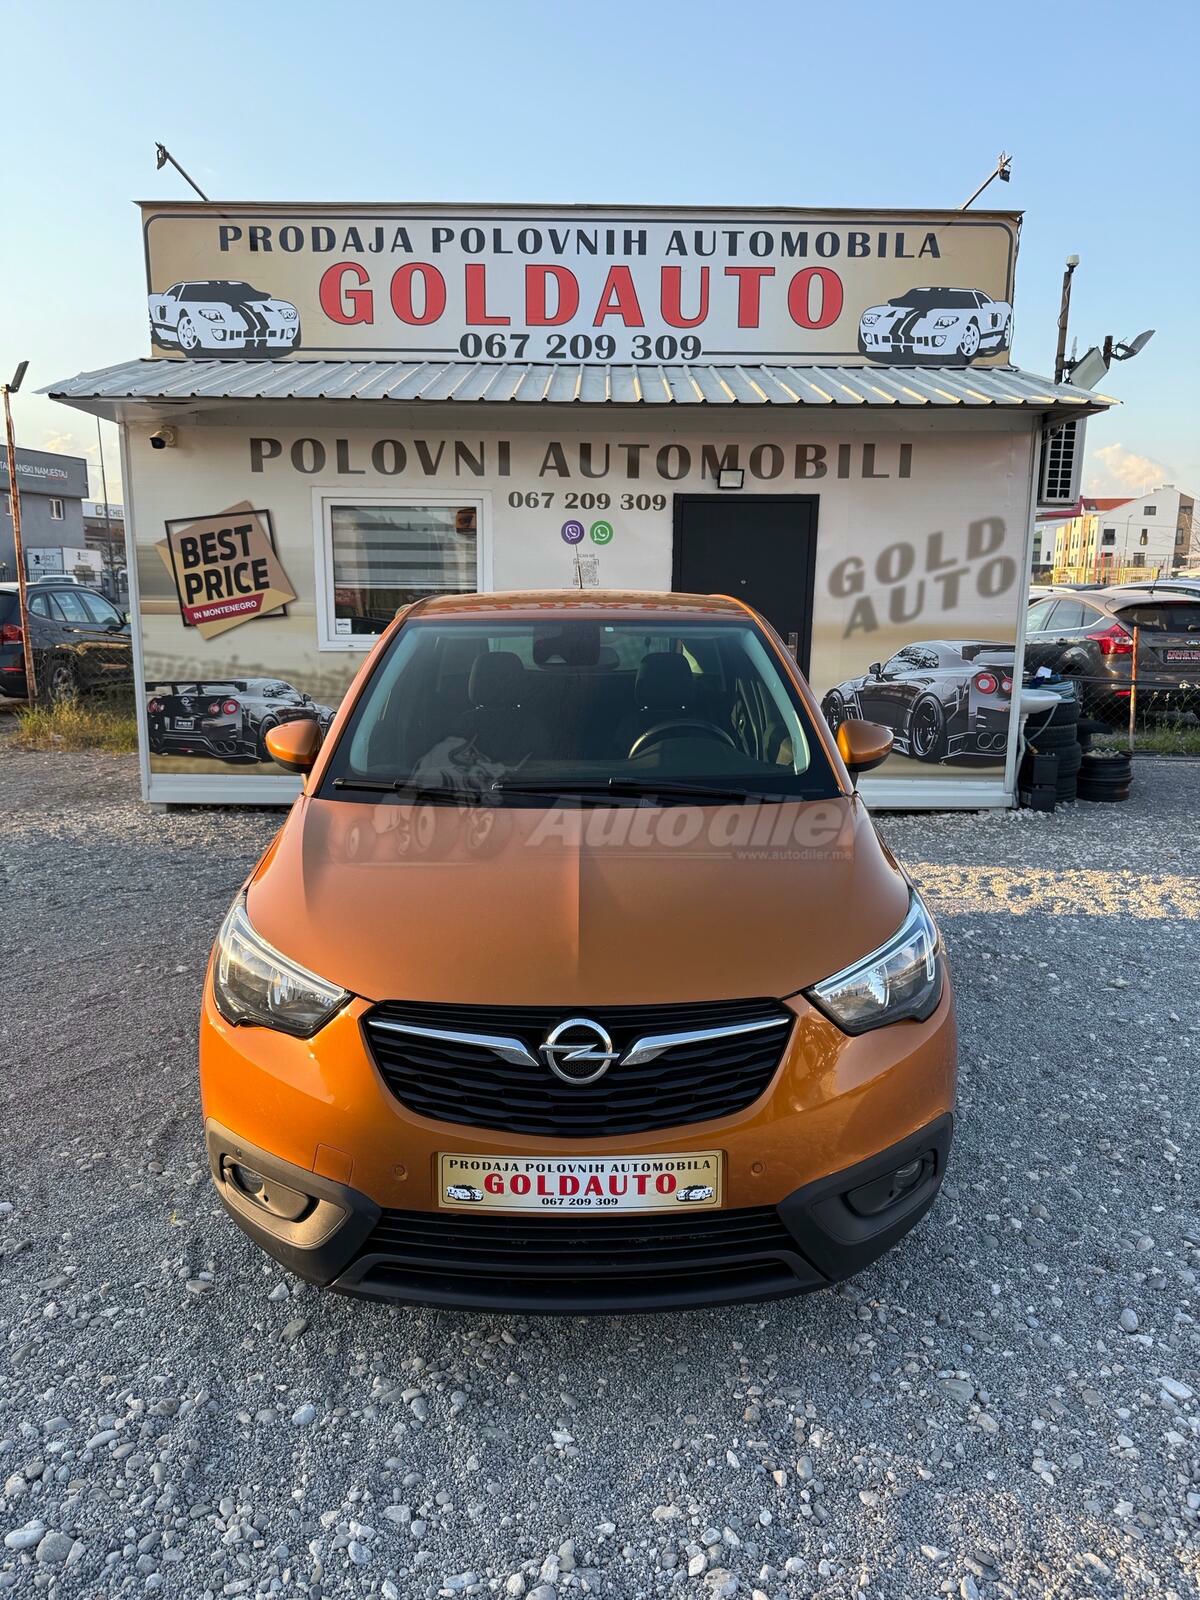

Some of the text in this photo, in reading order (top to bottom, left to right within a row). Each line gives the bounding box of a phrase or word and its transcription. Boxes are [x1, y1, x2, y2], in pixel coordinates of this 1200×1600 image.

[219, 225, 941, 259] PRODAJA POLOVNIH AUTOMOBILA
[318, 261, 844, 329] GOLDAUTO
[459, 332, 703, 361] 067 209 309
[249, 437, 913, 480] POLOVNI AUTOMOBILI
[508, 490, 667, 512] 067 209 309
[180, 524, 253, 570] BEST
[828, 516, 1006, 599] GOLD
[184, 558, 270, 605] PRICE
[843, 555, 1017, 639] AUTO
[193, 600, 257, 620] IN MONTENEGRO
[449, 1159, 711, 1173] PRODAJA POLOVNIH AUTOMOBILA
[483, 1173, 677, 1196] GOLDAUTO
[541, 1197, 618, 1206] 067 209 309
